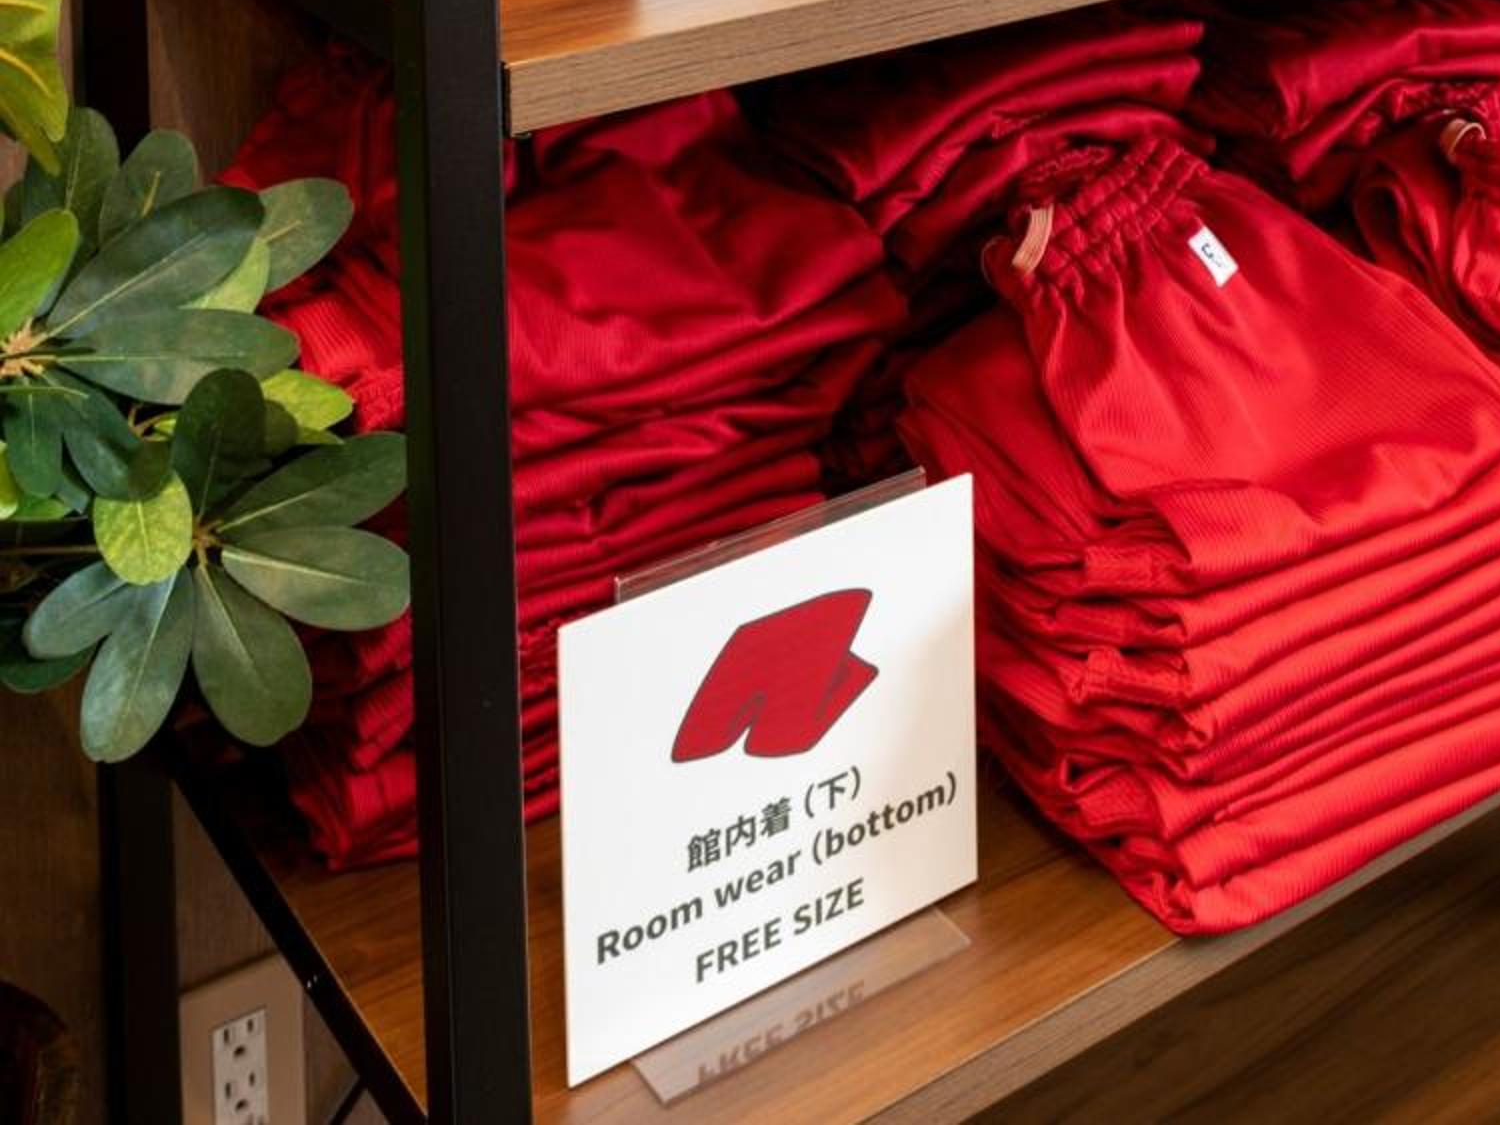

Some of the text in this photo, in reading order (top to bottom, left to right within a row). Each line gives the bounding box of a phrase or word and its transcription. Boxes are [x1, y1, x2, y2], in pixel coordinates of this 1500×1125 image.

[596, 771, 958, 966] Room wear (bottom)
[696, 877, 865, 984] FREE SIZE
